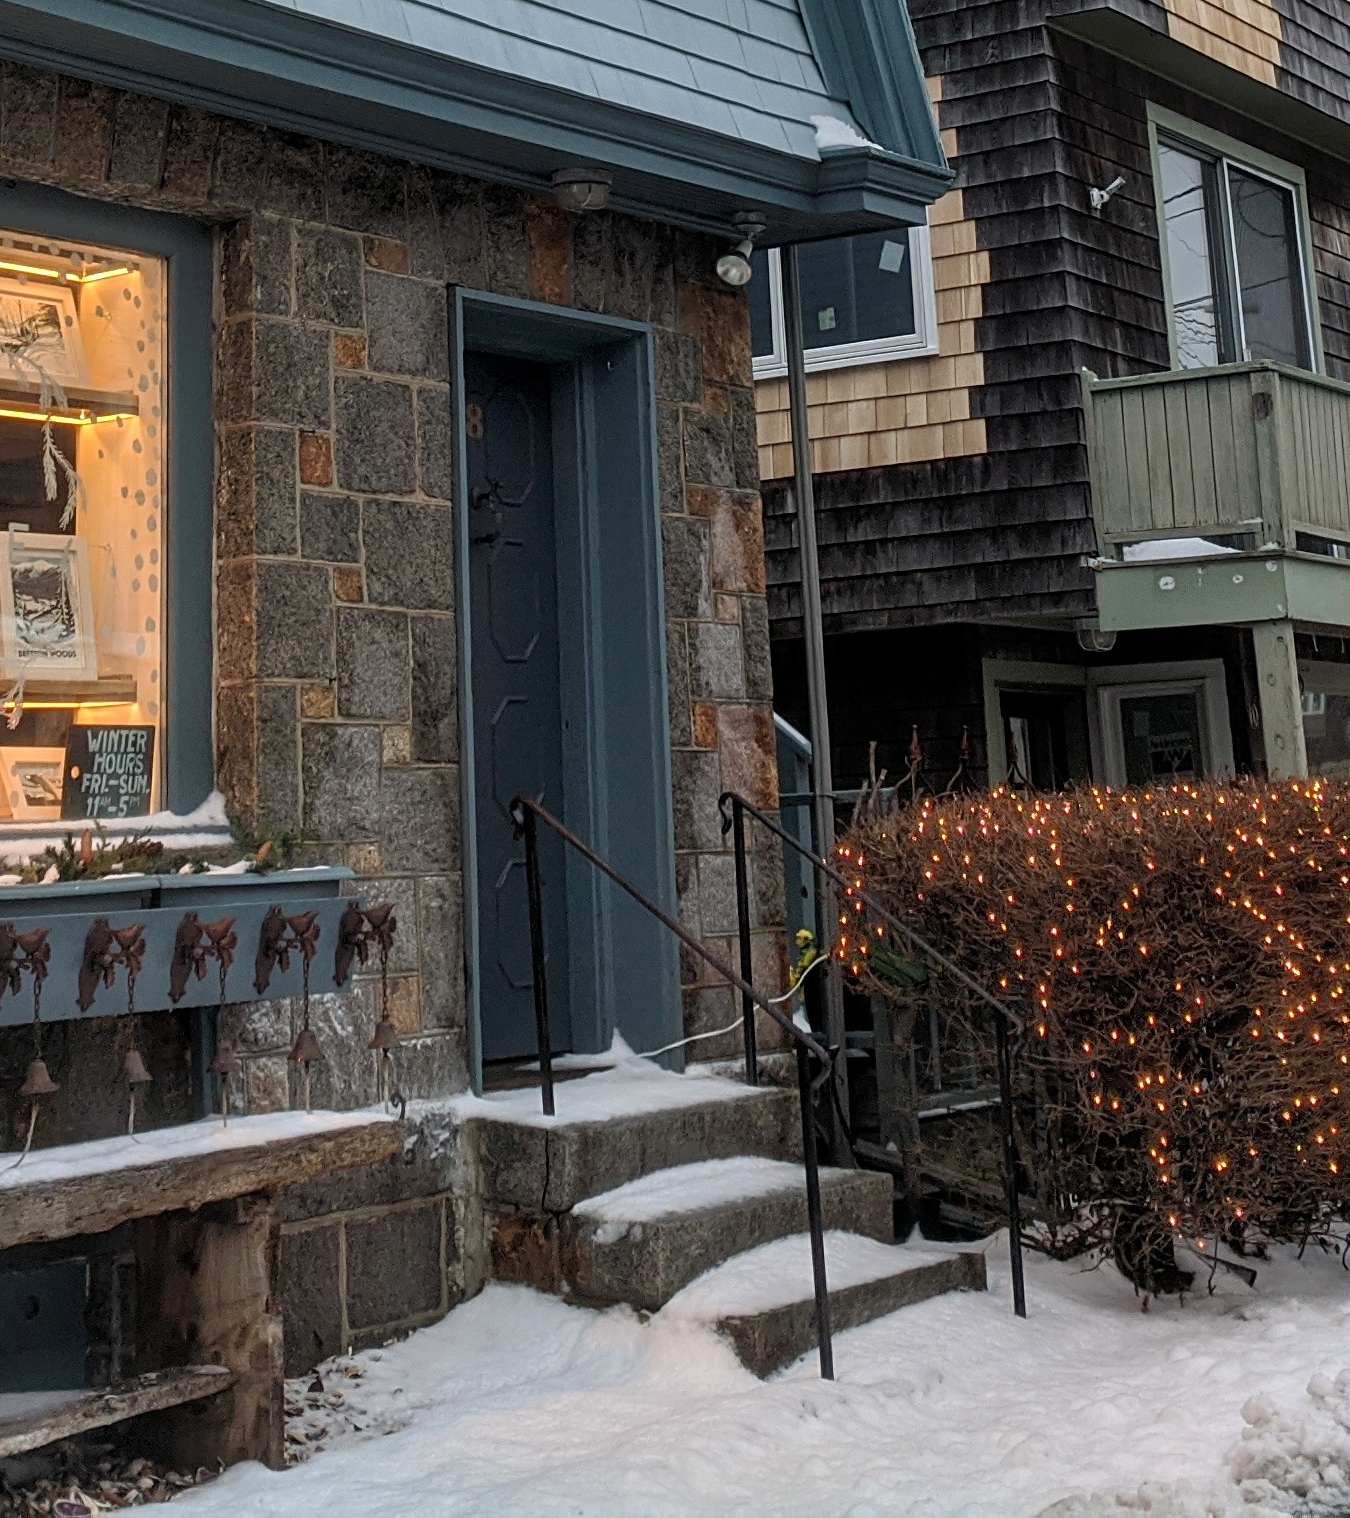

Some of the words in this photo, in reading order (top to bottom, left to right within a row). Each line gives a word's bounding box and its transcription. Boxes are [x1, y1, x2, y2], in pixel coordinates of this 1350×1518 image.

[465, 403, 484, 441] 8
[86, 729, 148, 753] WINTER
[92, 752, 144, 775] HOURS
